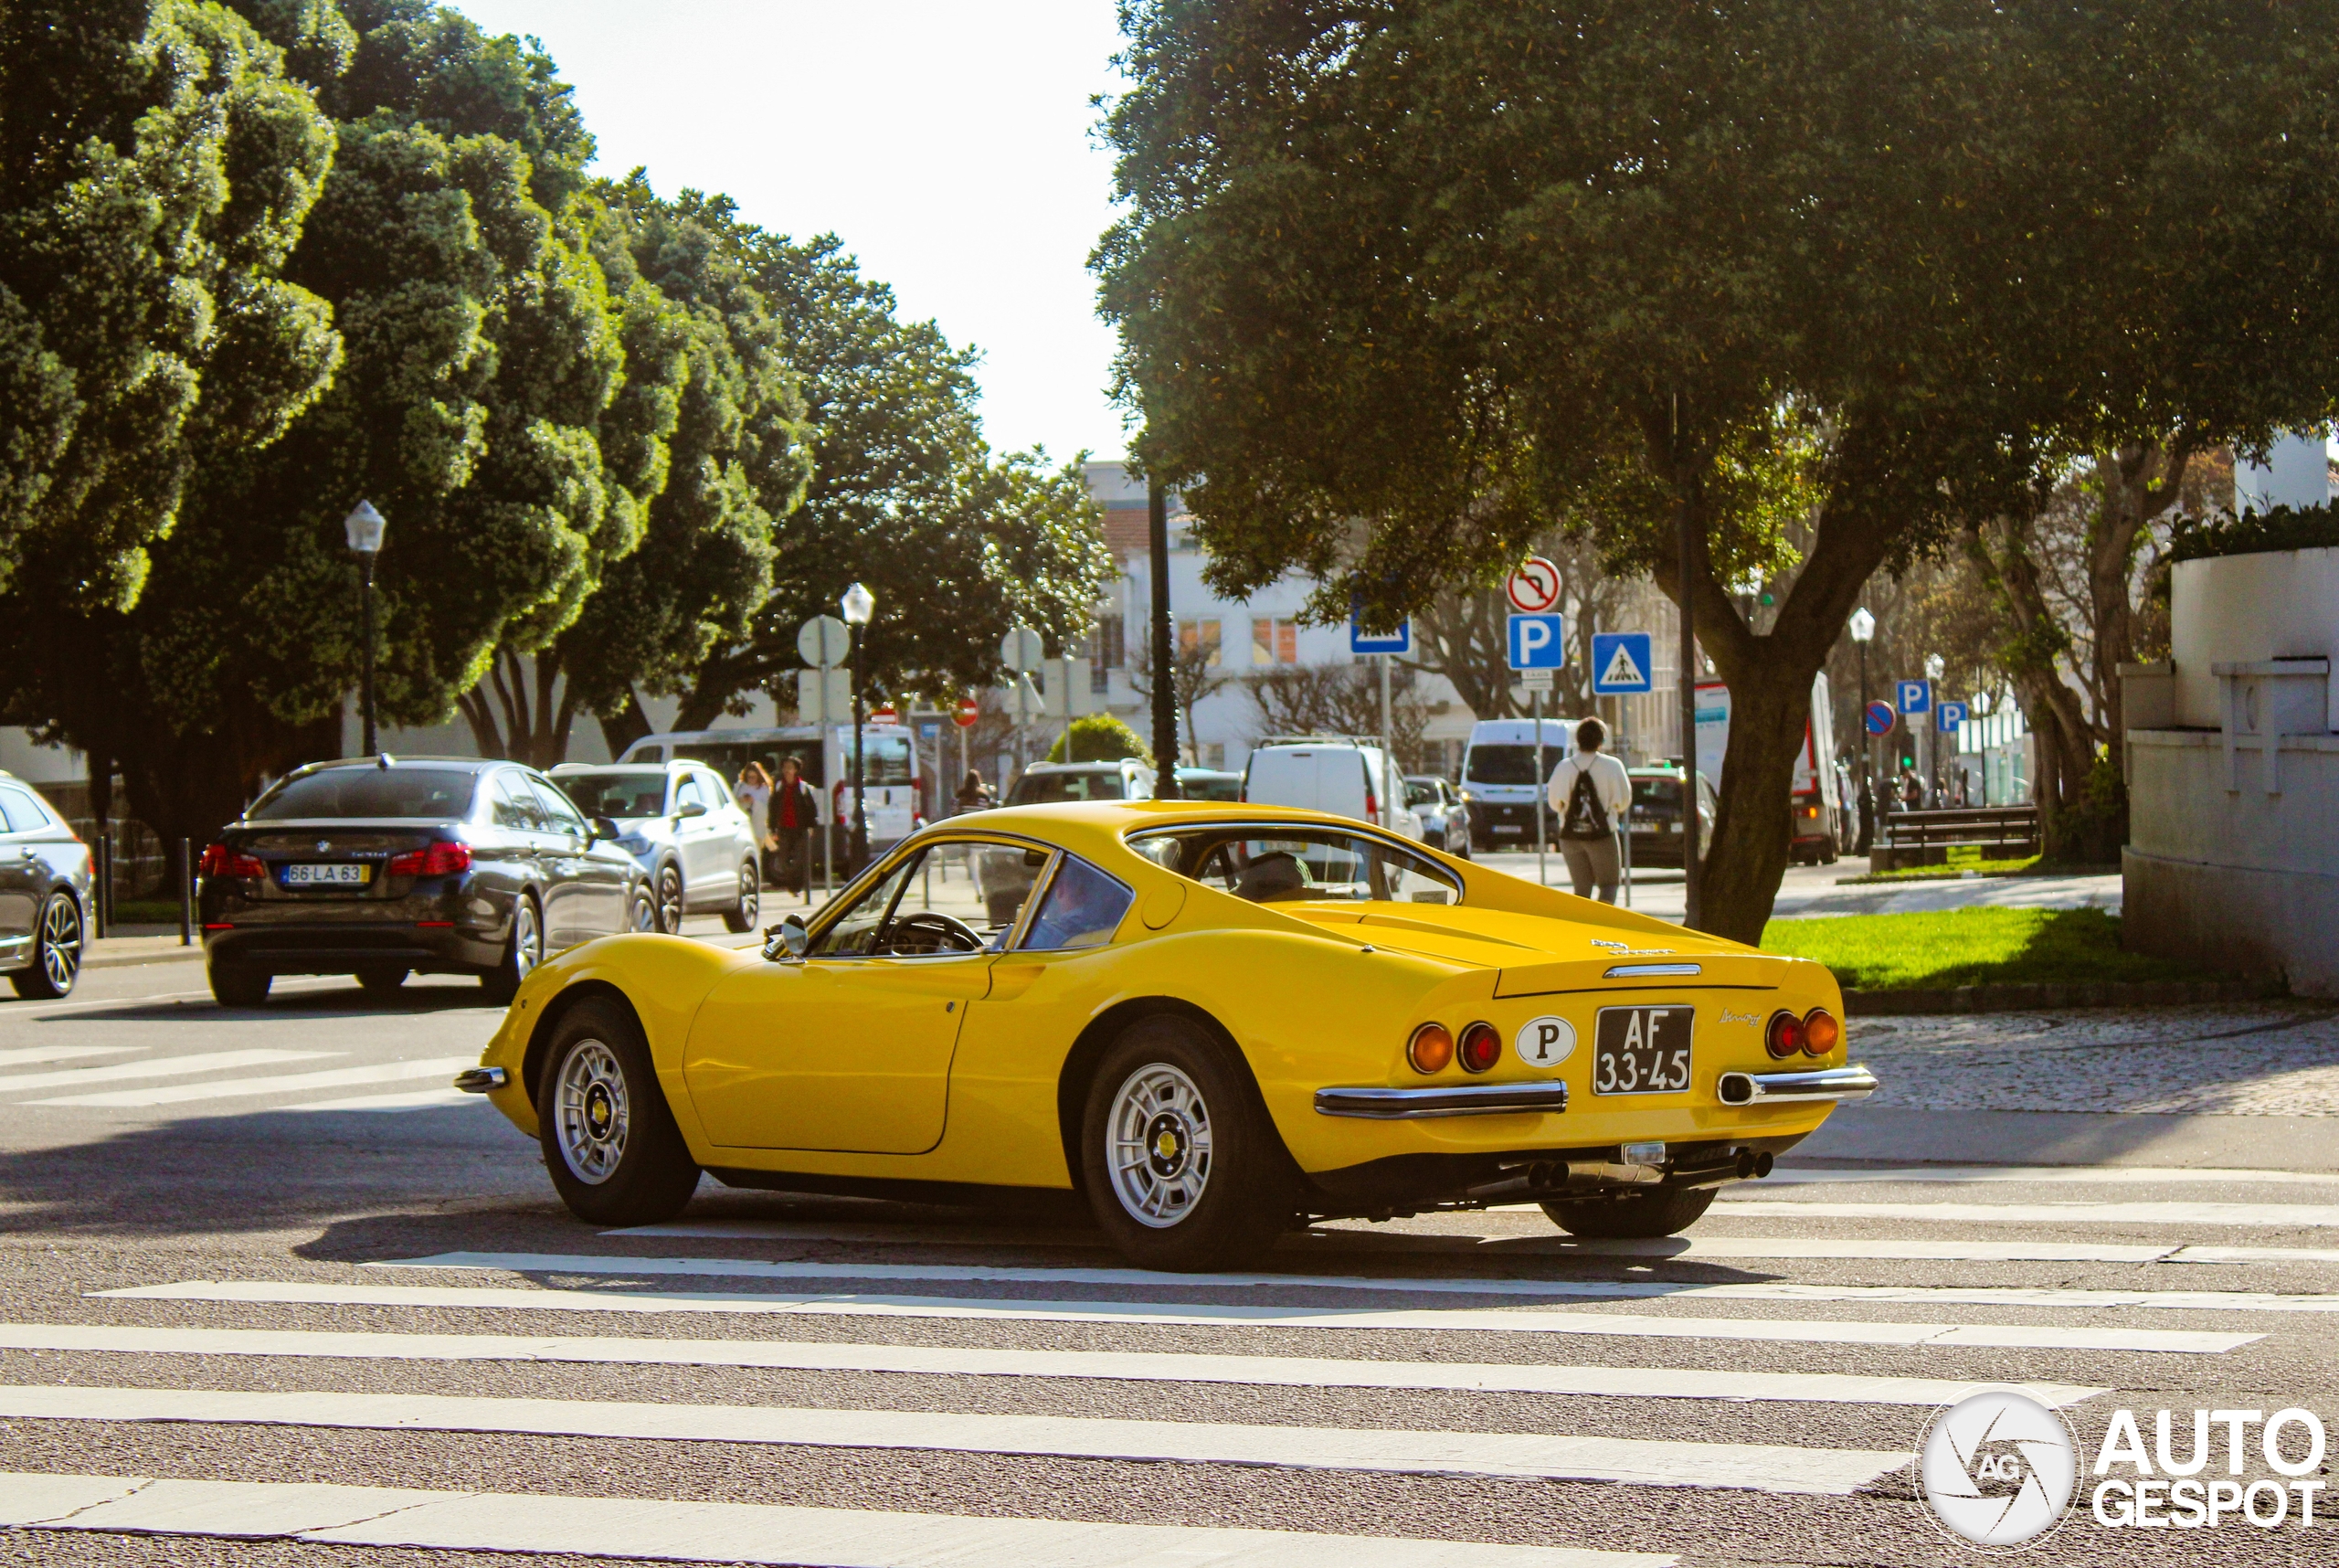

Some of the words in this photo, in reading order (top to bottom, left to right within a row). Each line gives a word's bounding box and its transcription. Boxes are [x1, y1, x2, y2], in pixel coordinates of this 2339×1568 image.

[1519, 620, 1551, 665] P
[1904, 684, 1922, 710] P
[1943, 705, 1962, 729] P
[1537, 1024, 1560, 1059] P
[1624, 1010, 1669, 1049] AF
[1596, 1050, 1688, 1091] 33-45
